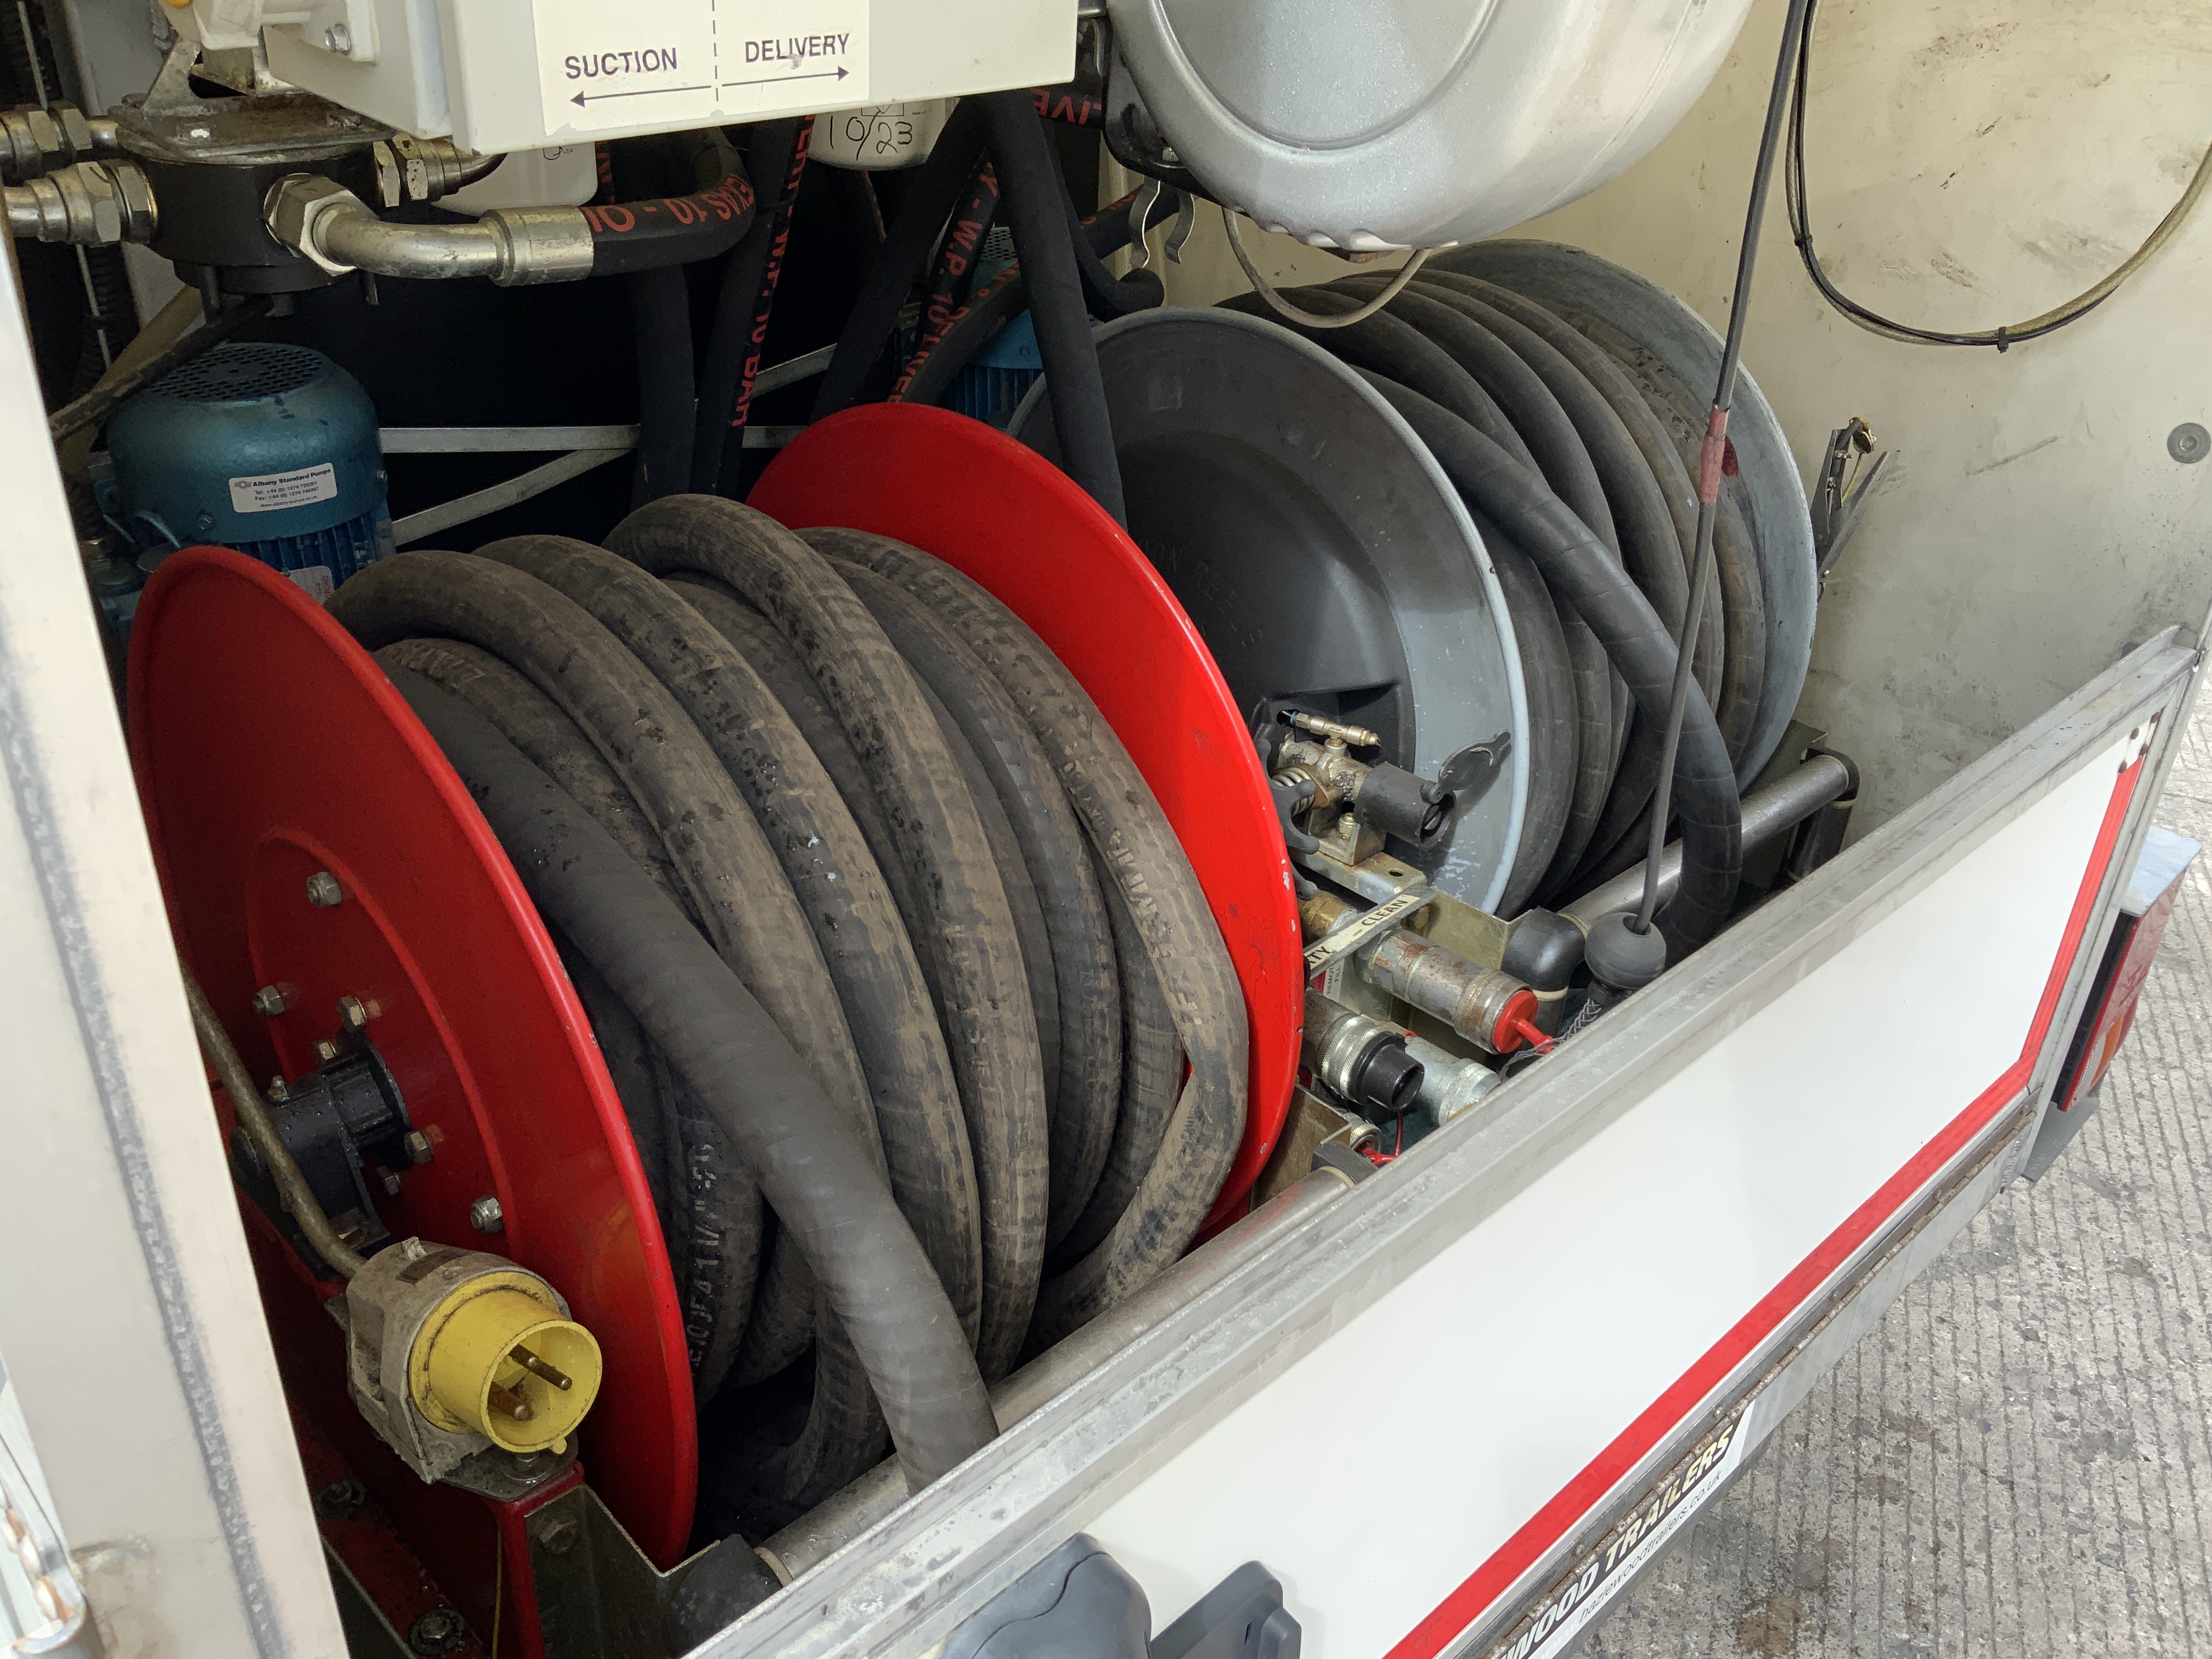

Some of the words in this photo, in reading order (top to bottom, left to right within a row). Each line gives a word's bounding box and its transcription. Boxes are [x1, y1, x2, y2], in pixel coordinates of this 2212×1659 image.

[565, 48, 677, 79] SUCTION
[745, 33, 850, 63] DELIVERY
[830, 110, 912, 161] 10/23
[939, 220, 982, 275] W.P.
[279, 474, 309, 483] Standard
[311, 469, 331, 477] Pumps
[1361, 900, 1409, 926] CLEAN
[1605, 1425, 1733, 1572] TRAILERS
